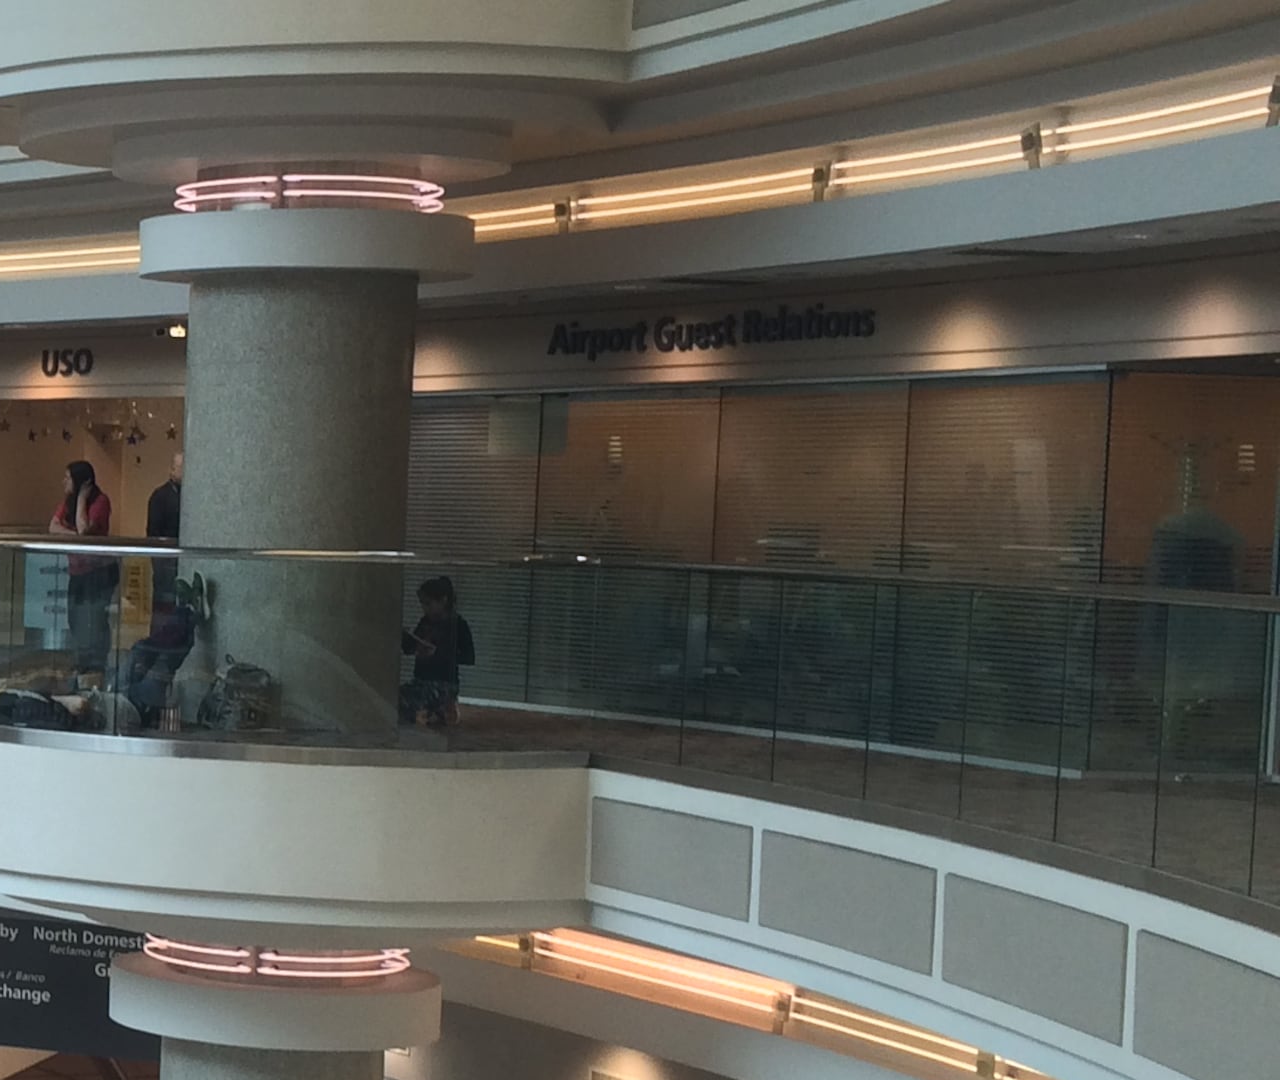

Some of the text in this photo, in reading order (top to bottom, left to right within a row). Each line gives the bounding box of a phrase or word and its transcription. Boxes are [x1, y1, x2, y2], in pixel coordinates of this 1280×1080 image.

[547, 303, 876, 362] Airport Guest Relations
[42, 349, 94, 378] USO
[33, 926, 143, 949] North Domest
[15, 971, 46, 983] Banco
